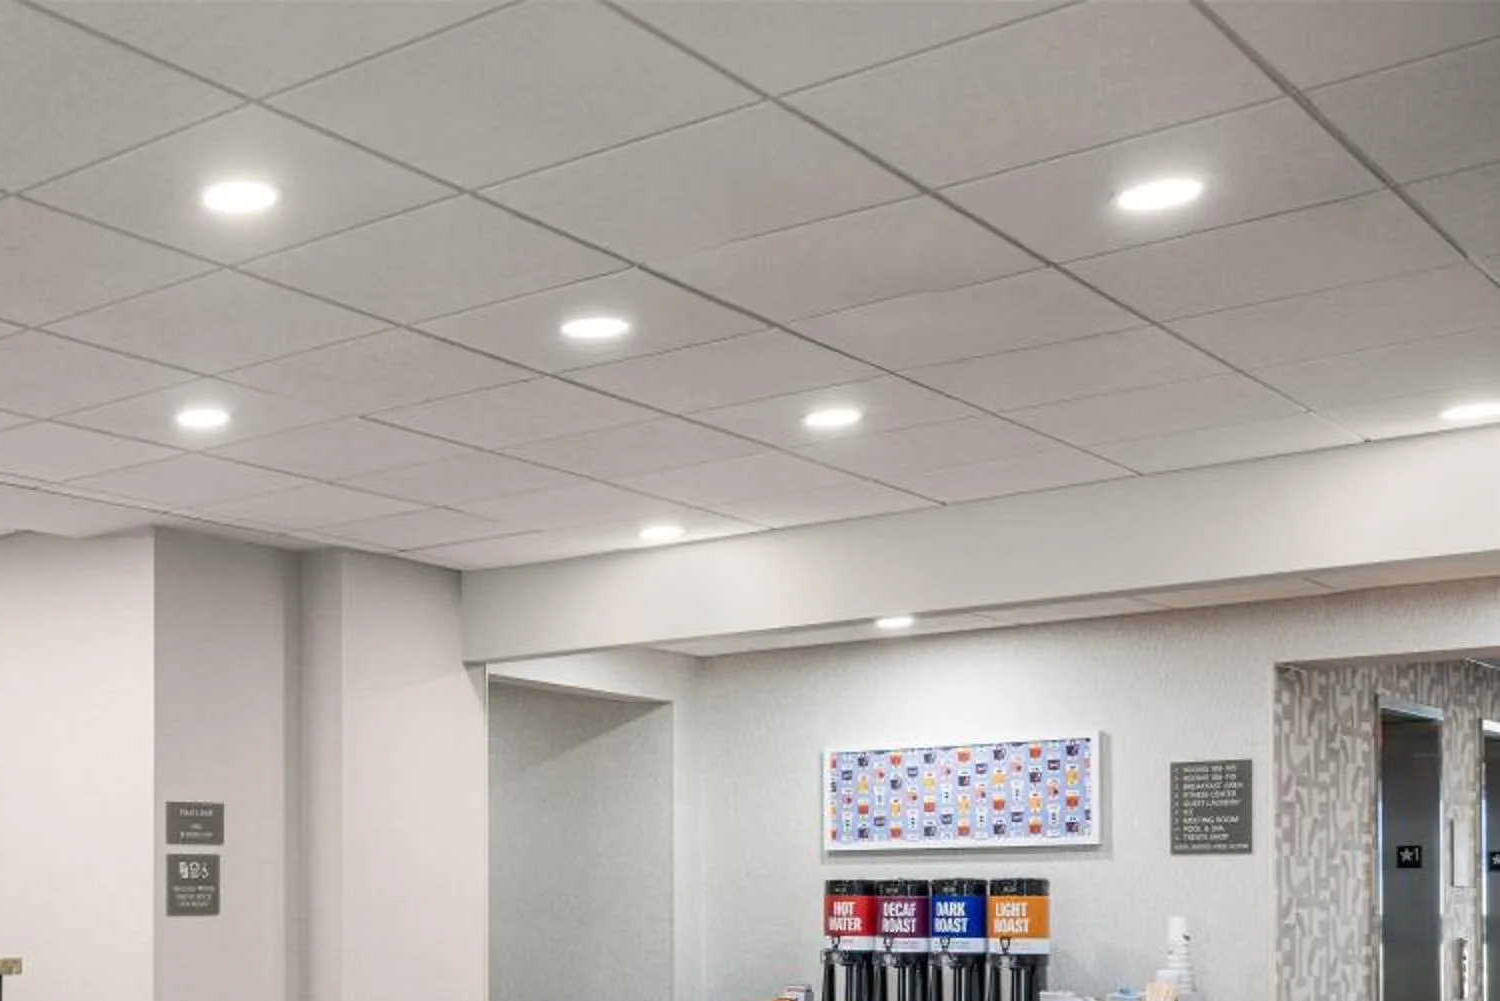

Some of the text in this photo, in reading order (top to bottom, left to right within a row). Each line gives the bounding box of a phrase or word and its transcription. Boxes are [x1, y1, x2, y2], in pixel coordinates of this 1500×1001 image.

[833, 901, 856, 917] HOT
[882, 901, 916, 917] DECAF
[936, 901, 966, 917] DARK
[995, 901, 1029, 917] LIGHT
[828, 917, 863, 932] WATER
[882, 917, 917, 933] ROAST
[934, 917, 969, 933] ROAST
[994, 917, 1030, 933] ROAST
